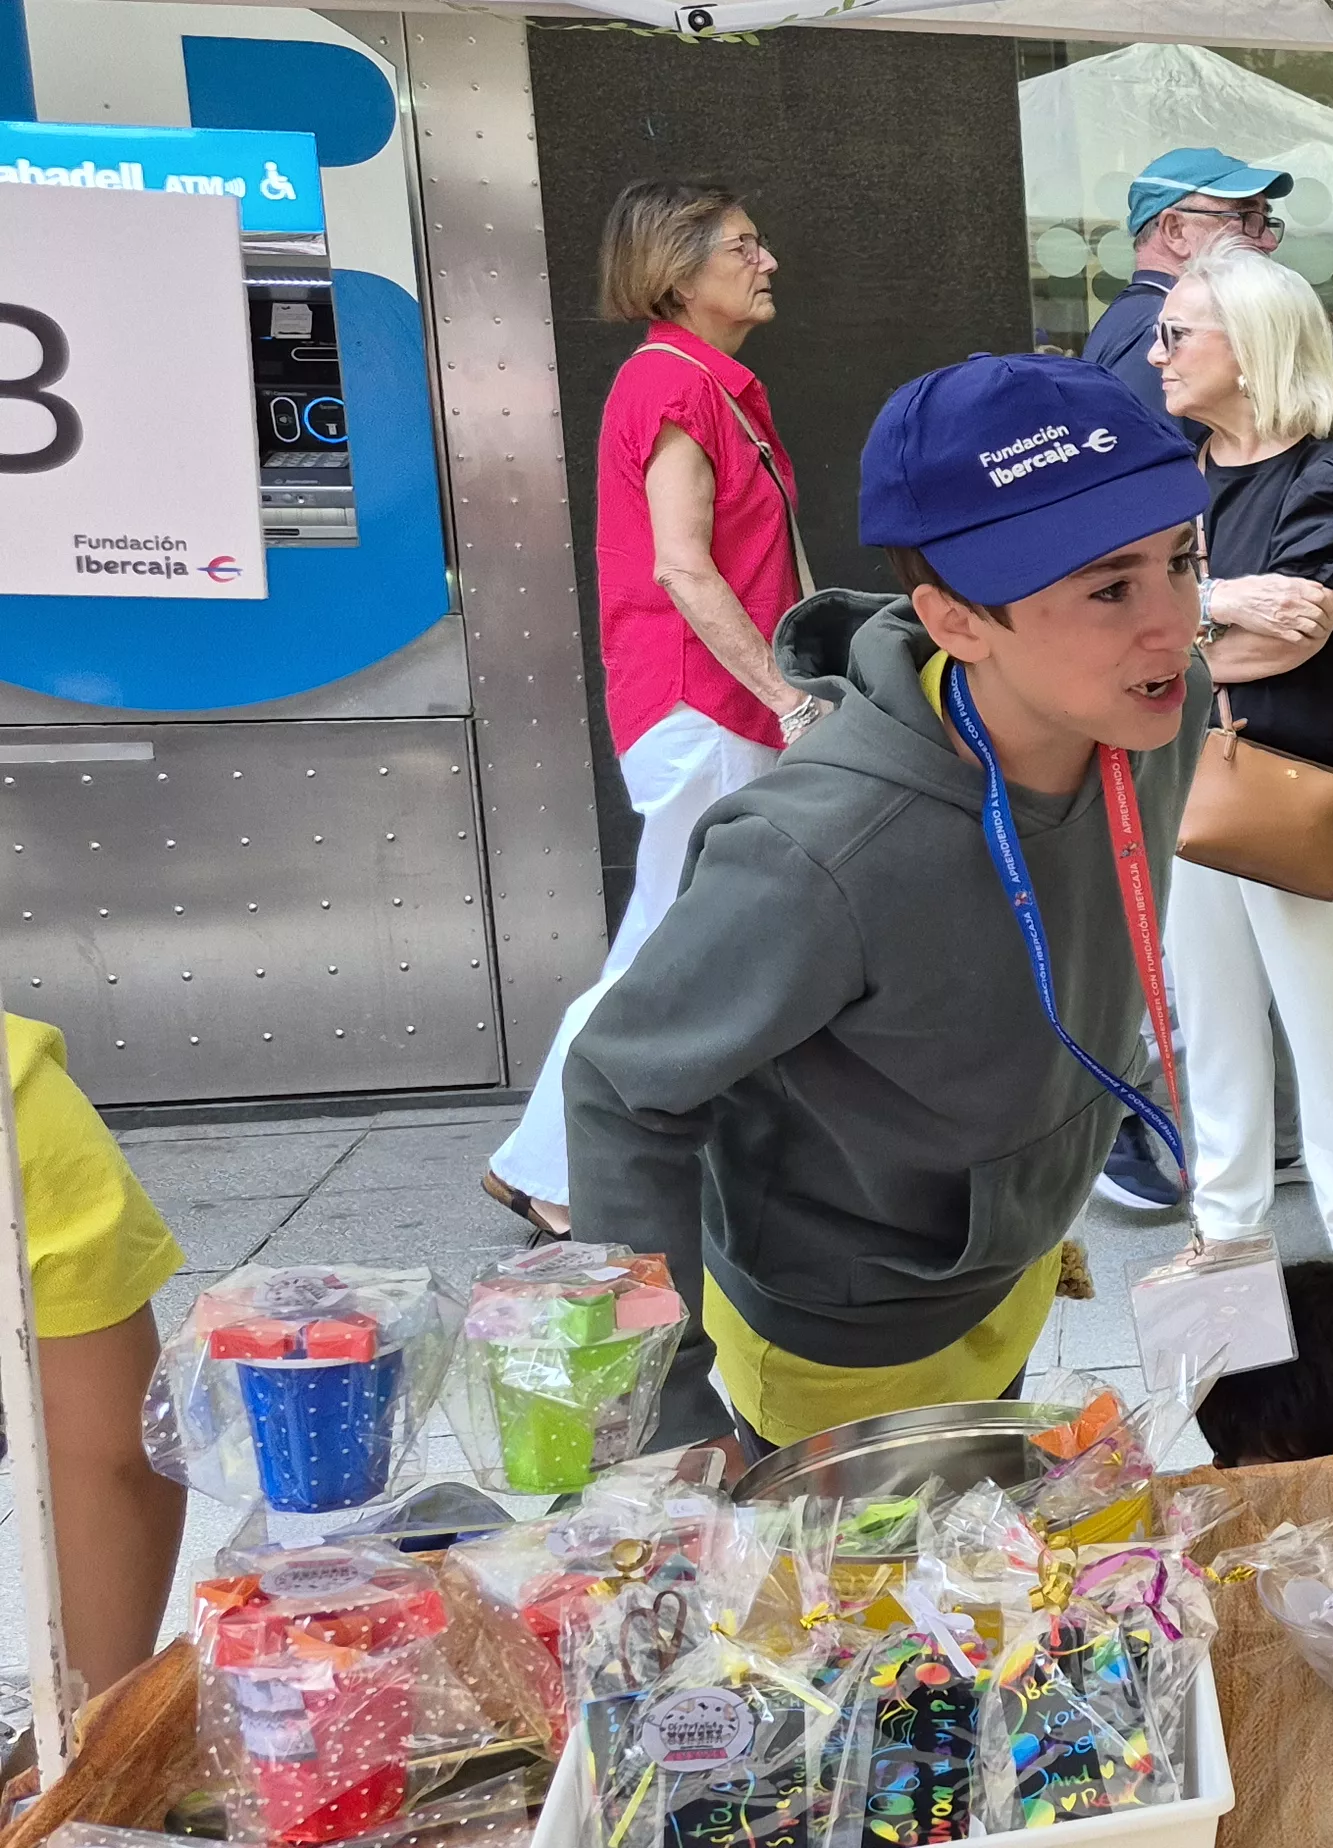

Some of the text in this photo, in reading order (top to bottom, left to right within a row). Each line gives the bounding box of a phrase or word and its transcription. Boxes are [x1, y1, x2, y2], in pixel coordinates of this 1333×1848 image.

[165, 174, 224, 197] ATM
[978, 425, 1070, 468] Fundación
[988, 441, 1081, 488] Ibercaja
[73, 534, 188, 552] Fundación
[75, 555, 189, 579] Ibercaja
[962, 717, 978, 741] CON
[991, 800, 1000, 809] A
[1110, 751, 1132, 834] APRENDIENDO A
[993, 810, 1021, 885] APRENDIENDO
[1129, 862, 1147, 911] IBERCAJA
[1024, 911, 1043, 968] IBERCAJA
[1138, 913, 1155, 972] FUNDACIÓN
[1151, 974, 1160, 996] CON
[1051, 1764, 1094, 1789] And
